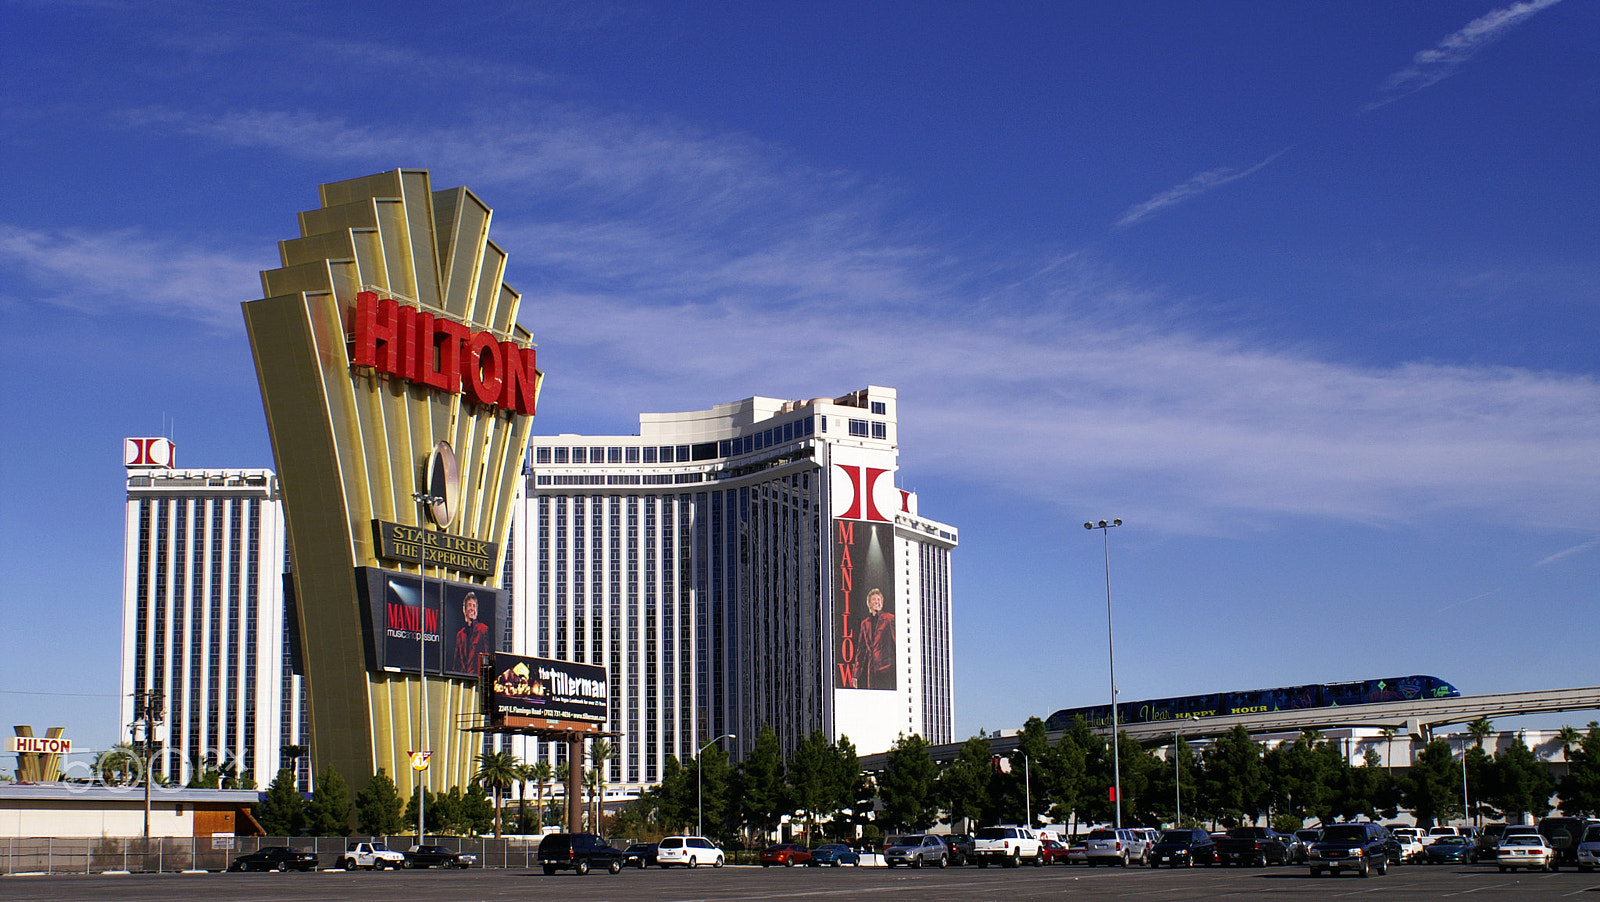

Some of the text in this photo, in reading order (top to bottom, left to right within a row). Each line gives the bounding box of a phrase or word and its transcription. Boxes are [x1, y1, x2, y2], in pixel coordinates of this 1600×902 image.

[355, 291, 536, 416] HILTON
[393, 526, 489, 556] STAR TREK
[393, 542, 489, 571] THE EXPERIENCE
[837, 520, 855, 687] MANILOW
[387, 629, 440, 642] musicandpssion
[1175, 709, 1216, 719] HAPPY
[1231, 705, 1268, 714] HOUR
[16, 738, 71, 752] HILTON
